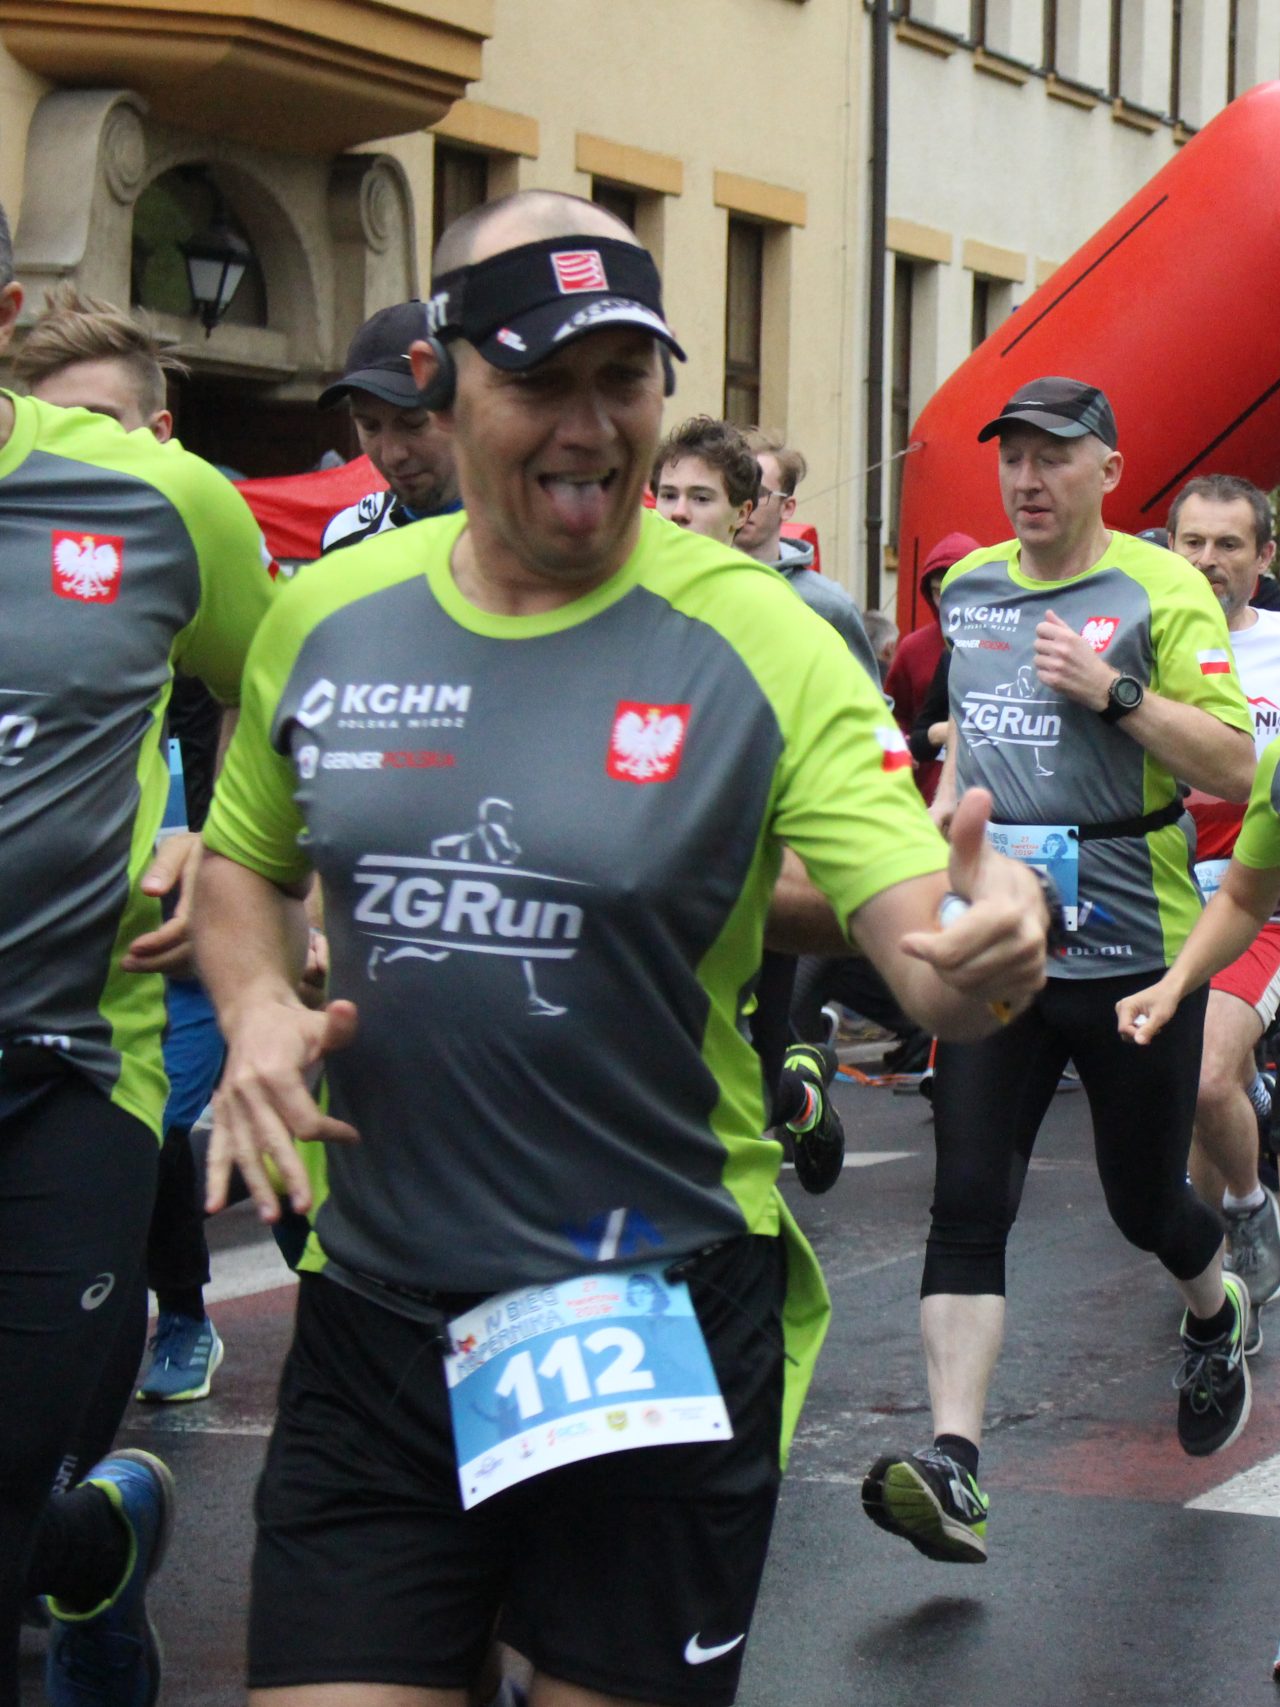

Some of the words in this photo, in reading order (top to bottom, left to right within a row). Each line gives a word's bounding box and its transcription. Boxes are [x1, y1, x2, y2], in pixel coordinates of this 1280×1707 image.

[964, 607, 1021, 624] KGHM
[340, 683, 473, 715] KGHM
[960, 701, 1062, 737] ZGRun
[353, 872, 584, 940] ZGRun
[495, 1326, 656, 1420] 112
